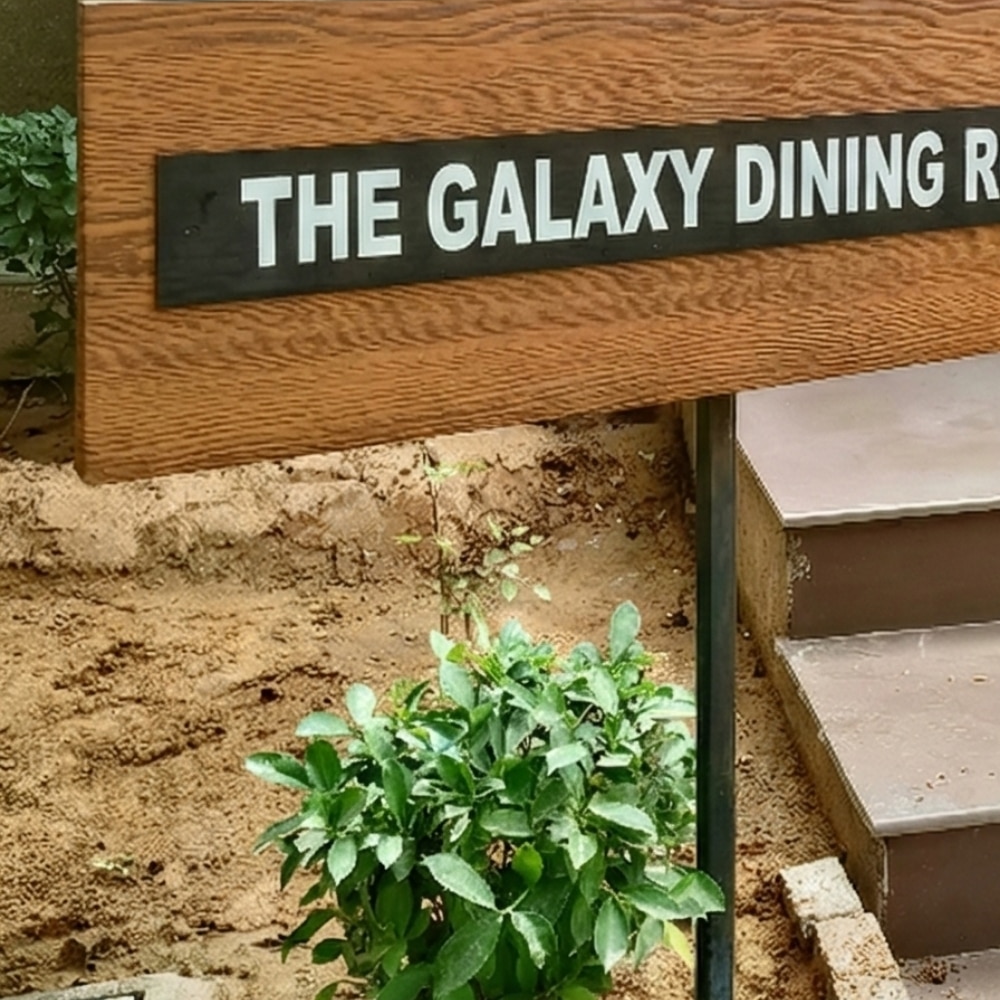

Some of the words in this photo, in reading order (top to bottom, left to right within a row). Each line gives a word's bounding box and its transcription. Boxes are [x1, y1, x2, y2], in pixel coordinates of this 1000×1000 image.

[241, 168, 401, 267] THE
[428, 147, 714, 251] GALAXY
[736, 130, 944, 223] DINING
